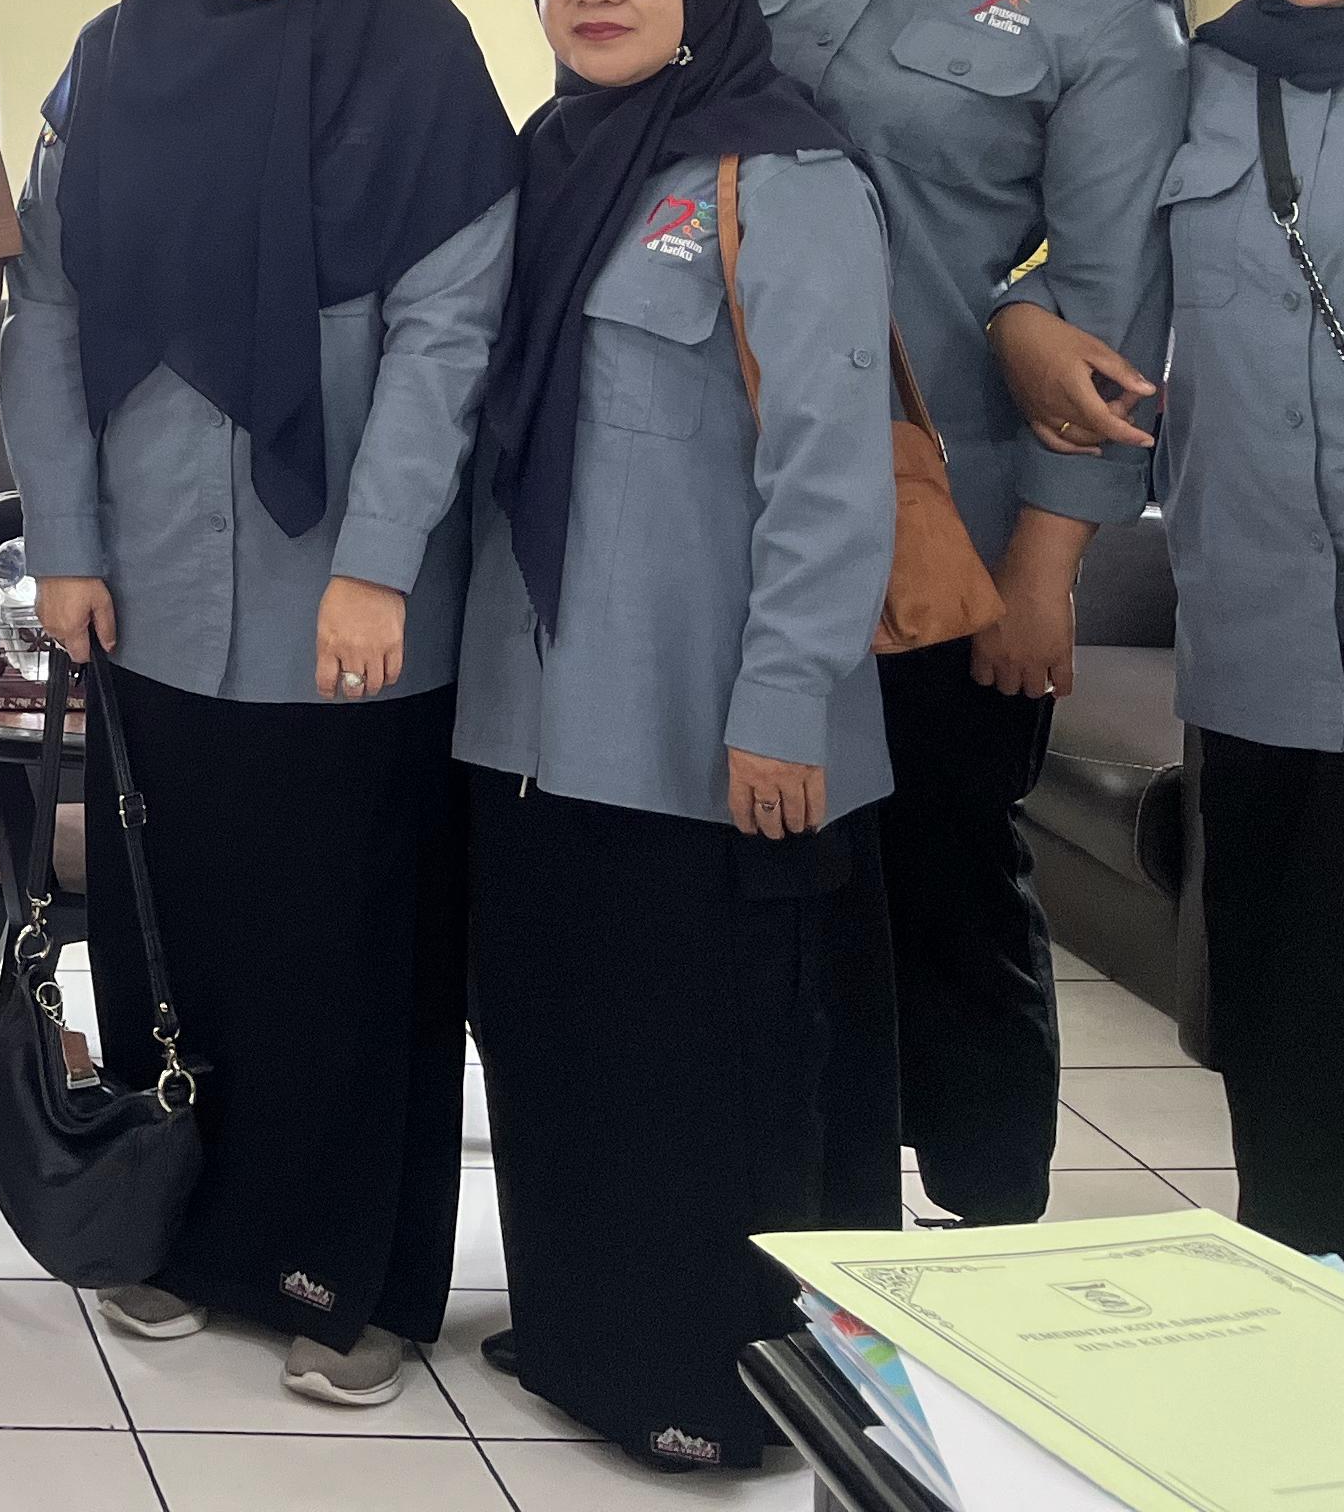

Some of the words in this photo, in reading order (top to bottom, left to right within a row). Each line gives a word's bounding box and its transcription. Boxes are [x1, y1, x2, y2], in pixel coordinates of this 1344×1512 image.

[974, 11, 988, 23] di
[988, 14, 1021, 35] hatiku
[989, 5, 1031, 26] museum
[646, 239, 660, 251] di
[660, 241, 694, 262] hatiku
[661, 233, 703, 254] museum
[1017, 1325, 1123, 1343] PEMERINTAH
[1124, 1320, 1170, 1334] KOTA
